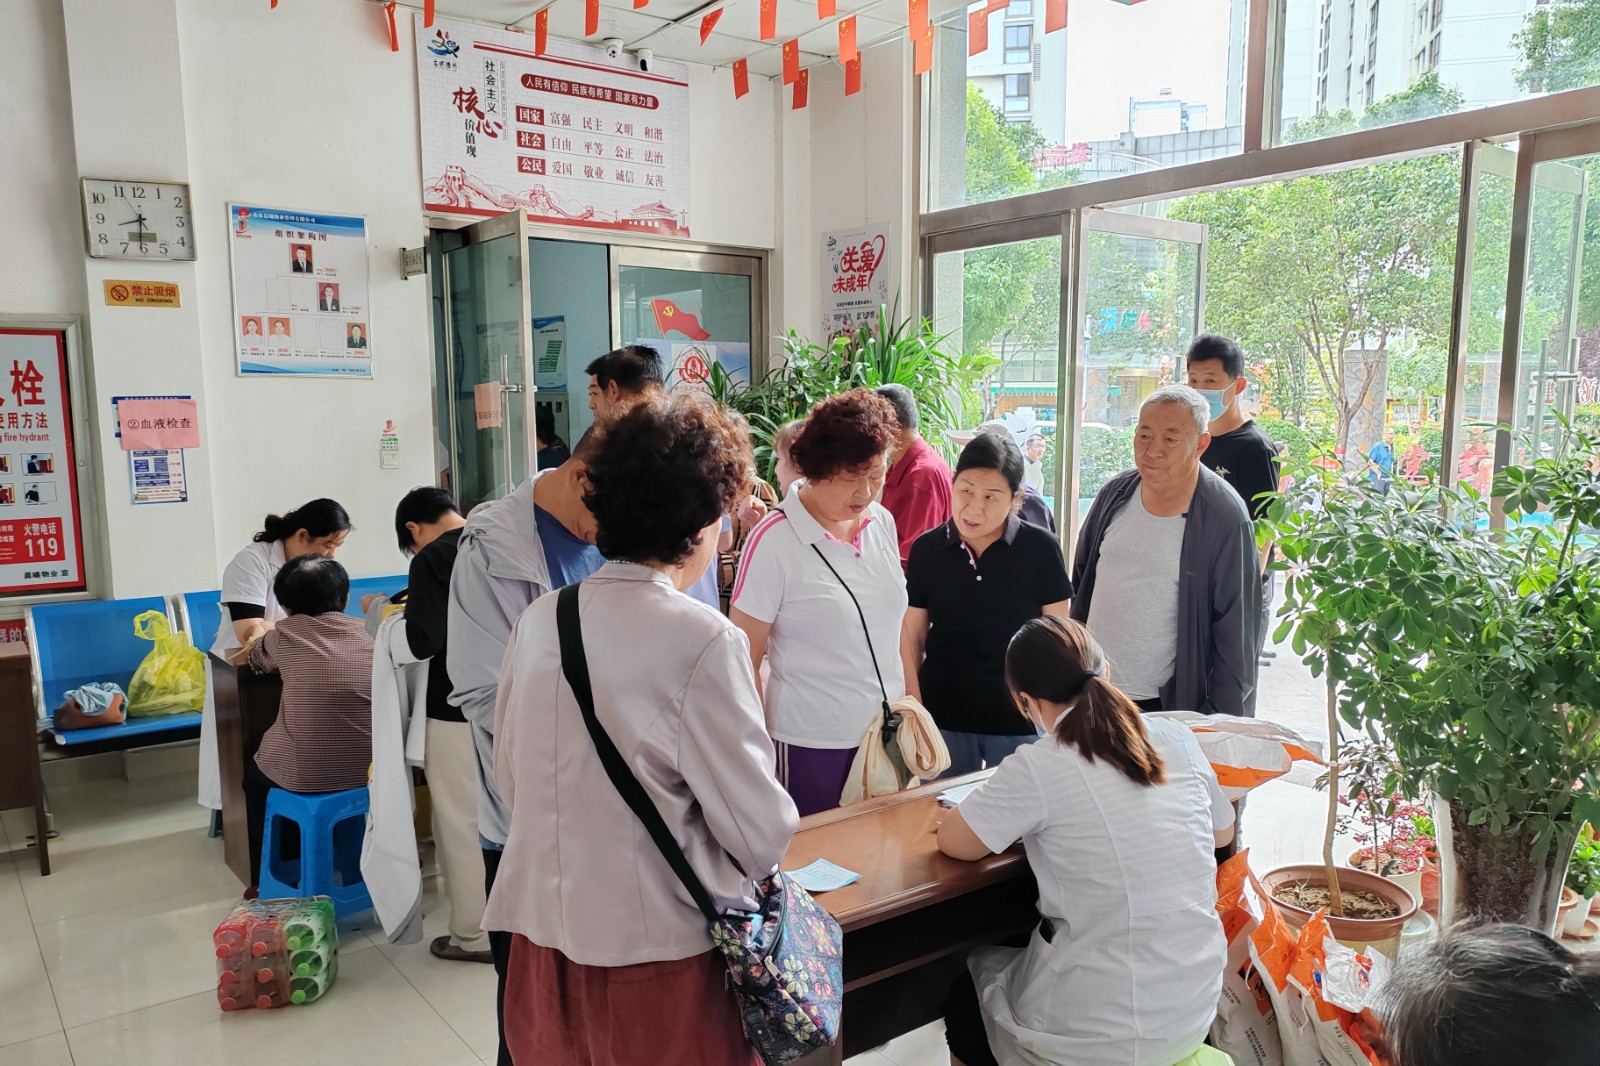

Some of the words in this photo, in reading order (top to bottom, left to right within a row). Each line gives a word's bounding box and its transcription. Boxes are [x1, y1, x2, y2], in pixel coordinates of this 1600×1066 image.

[485, 60, 497, 114] 社会主义
[526, 76, 568, 93] 人民有信仰
[571, 84, 612, 101] 民族有希望
[615, 91, 654, 108] 国家有力量
[452, 86, 503, 139] 核心
[519, 108, 541, 123] 国家
[550, 112, 571, 127] 富强
[583, 117, 603, 131] 民主
[614, 122, 633, 136] 文明
[644, 126, 663, 141] 和谐
[465, 118, 477, 158] 价值观
[520, 132, 542, 148] 社会
[551, 136, 571, 151] 自由
[584, 142, 603, 156] 平等
[615, 146, 634, 160] 公正
[645, 150, 663, 164] 法治
[521, 158, 542, 172] 公民
[551, 161, 572, 176] 爱国
[583, 165, 604, 179] 敬业
[615, 169, 634, 184] 诚信
[645, 173, 664, 187] 友善
[92, 192, 105, 204] 10
[114, 185, 124, 198] 11
[131, 186, 146, 199] 12
[155, 188, 162, 200] 1
[173, 196, 183, 208] 2
[96, 213, 105, 224] 9
[175, 216, 184, 228] 3
[98, 233, 108, 245] 8
[176, 236, 186, 247] 4
[274, 229, 327, 241] 组织架构图
[120, 242, 129, 255] 7
[140, 243, 149, 254] 6
[159, 243, 168, 254] 5
[840, 241, 876, 273] 关爱
[832, 274, 868, 294] 未成年
[131, 285, 177, 297] 禁止吸烟
[0, 359, 45, 407] 栓
[4, 432, 18, 442] fire
[19, 432, 50, 443] hydrant
[24, 522, 57, 536] 火警电话
[25, 537, 58, 558] 119
